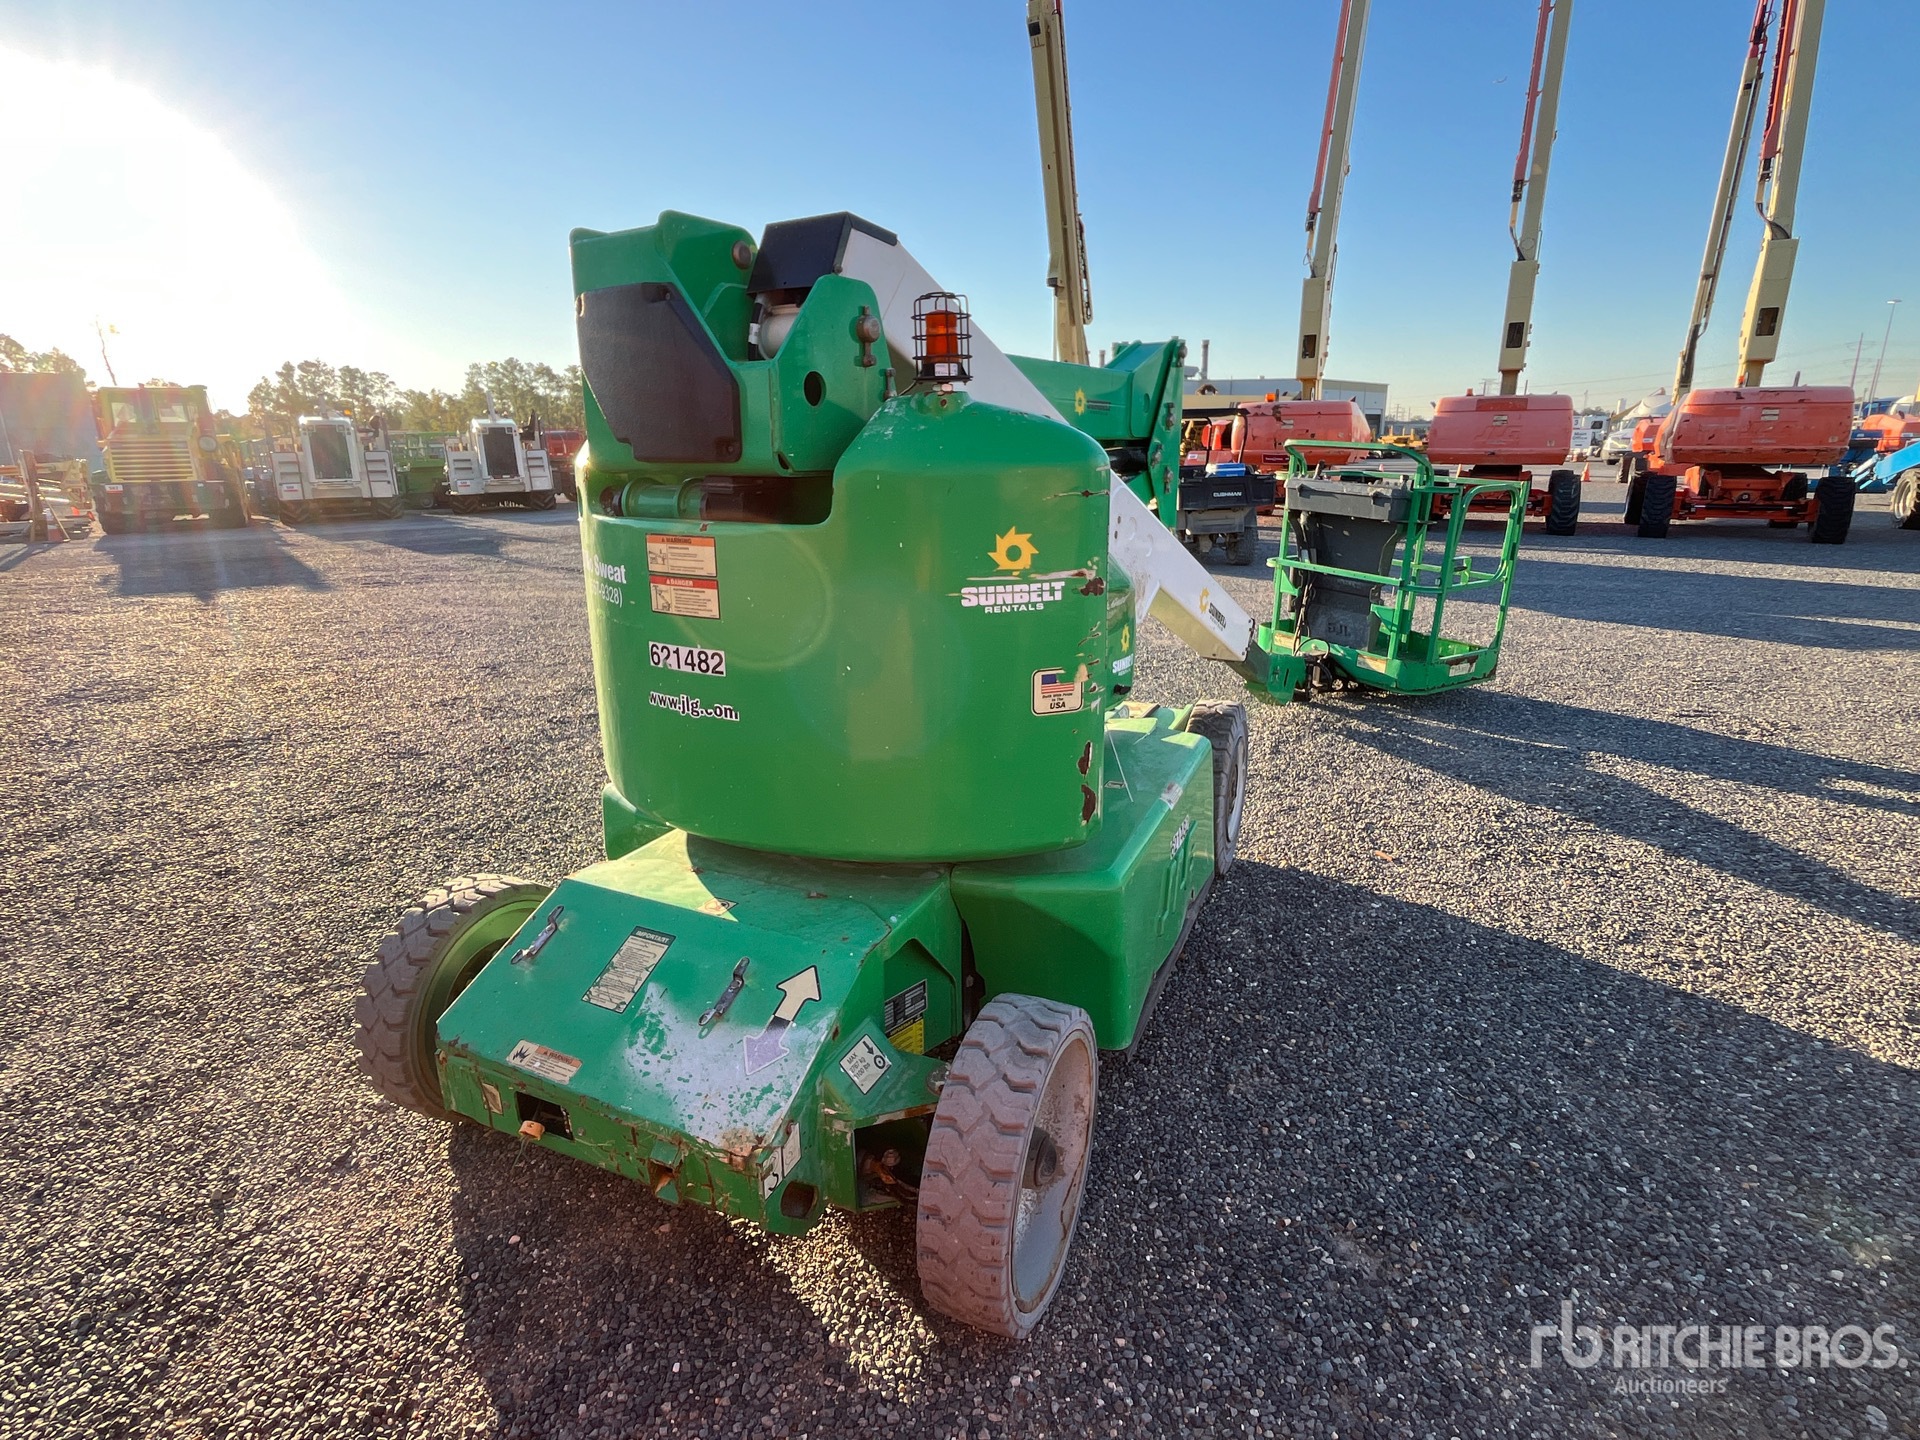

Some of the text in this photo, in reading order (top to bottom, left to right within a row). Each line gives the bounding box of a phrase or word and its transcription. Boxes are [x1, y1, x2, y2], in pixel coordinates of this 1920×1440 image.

[594, 554, 627, 584] Sweat
[671, 579, 694, 587] DANGER
[961, 581, 1065, 607] SUNBELT
[984, 602, 1044, 614] RENTALS
[650, 643, 724, 676] 621482
[1050, 701, 1066, 710] USA
[635, 930, 670, 944] IMPORTANT
[846, 1052, 858, 1065] MAX
